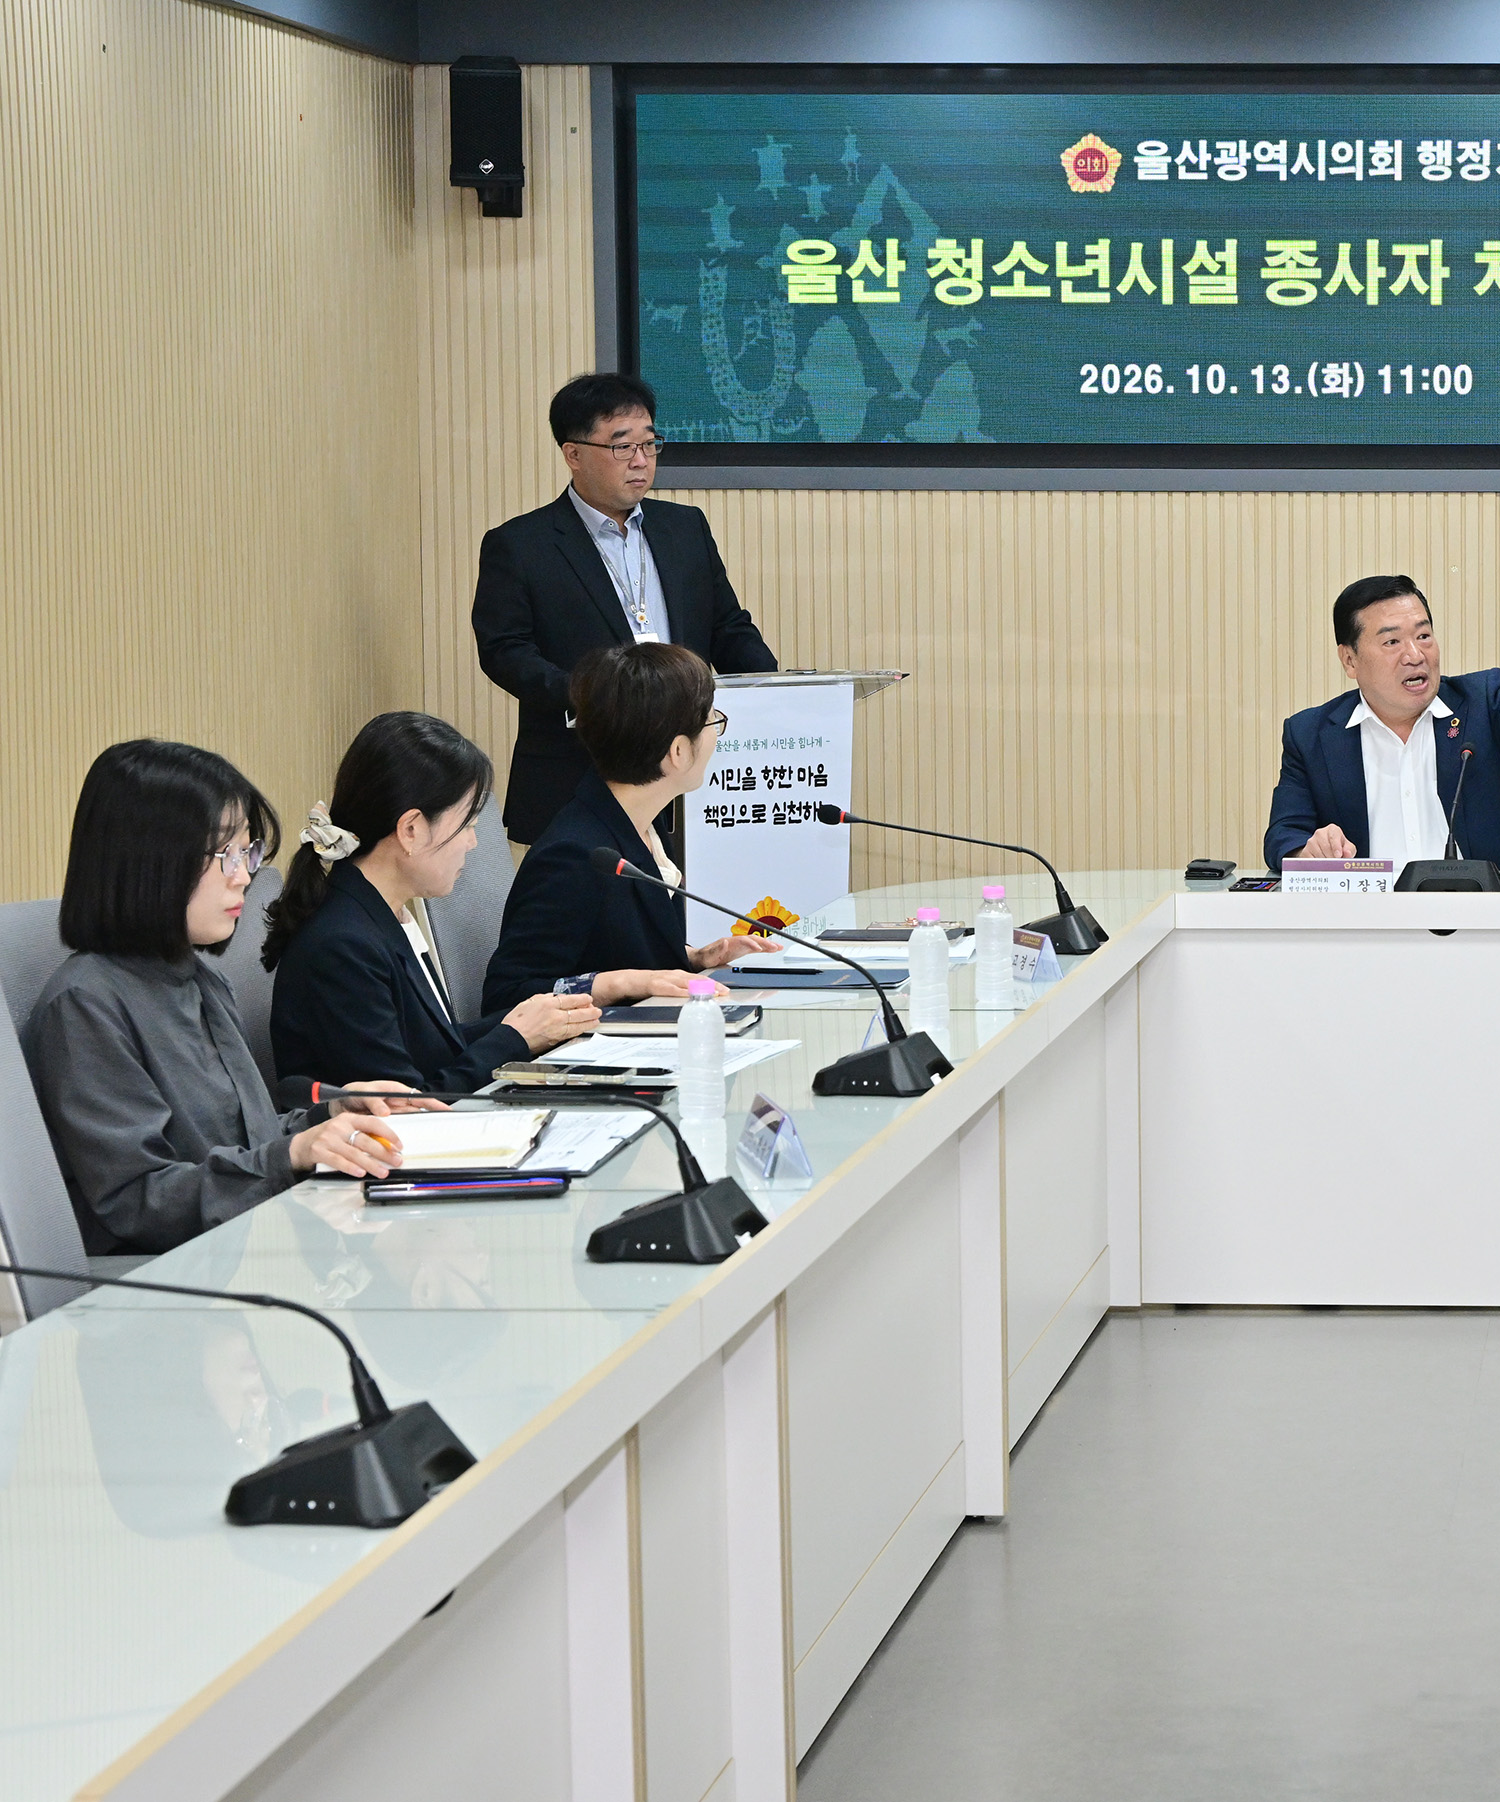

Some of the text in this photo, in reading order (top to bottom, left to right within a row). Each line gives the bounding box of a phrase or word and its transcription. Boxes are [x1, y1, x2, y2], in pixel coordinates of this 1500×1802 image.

[1075, 156, 1106, 172] 의회
[1133, 139, 1403, 181] 울산광역시의회
[781, 237, 906, 304] 울산
[926, 237, 1238, 306] 청소년시설
[1260, 237, 1450, 306] 종사자
[1080, 363, 1174, 395] 2026.
[1186, 363, 1238, 395] 10.
[1378, 363, 1473, 395] 11:00
[716, 736, 823, 752] 울산을 새롭게 시민을 힘나게
[709, 763, 828, 791] 시민을 향한 마음
[703, 800, 823, 828] 책임으로 실천하
